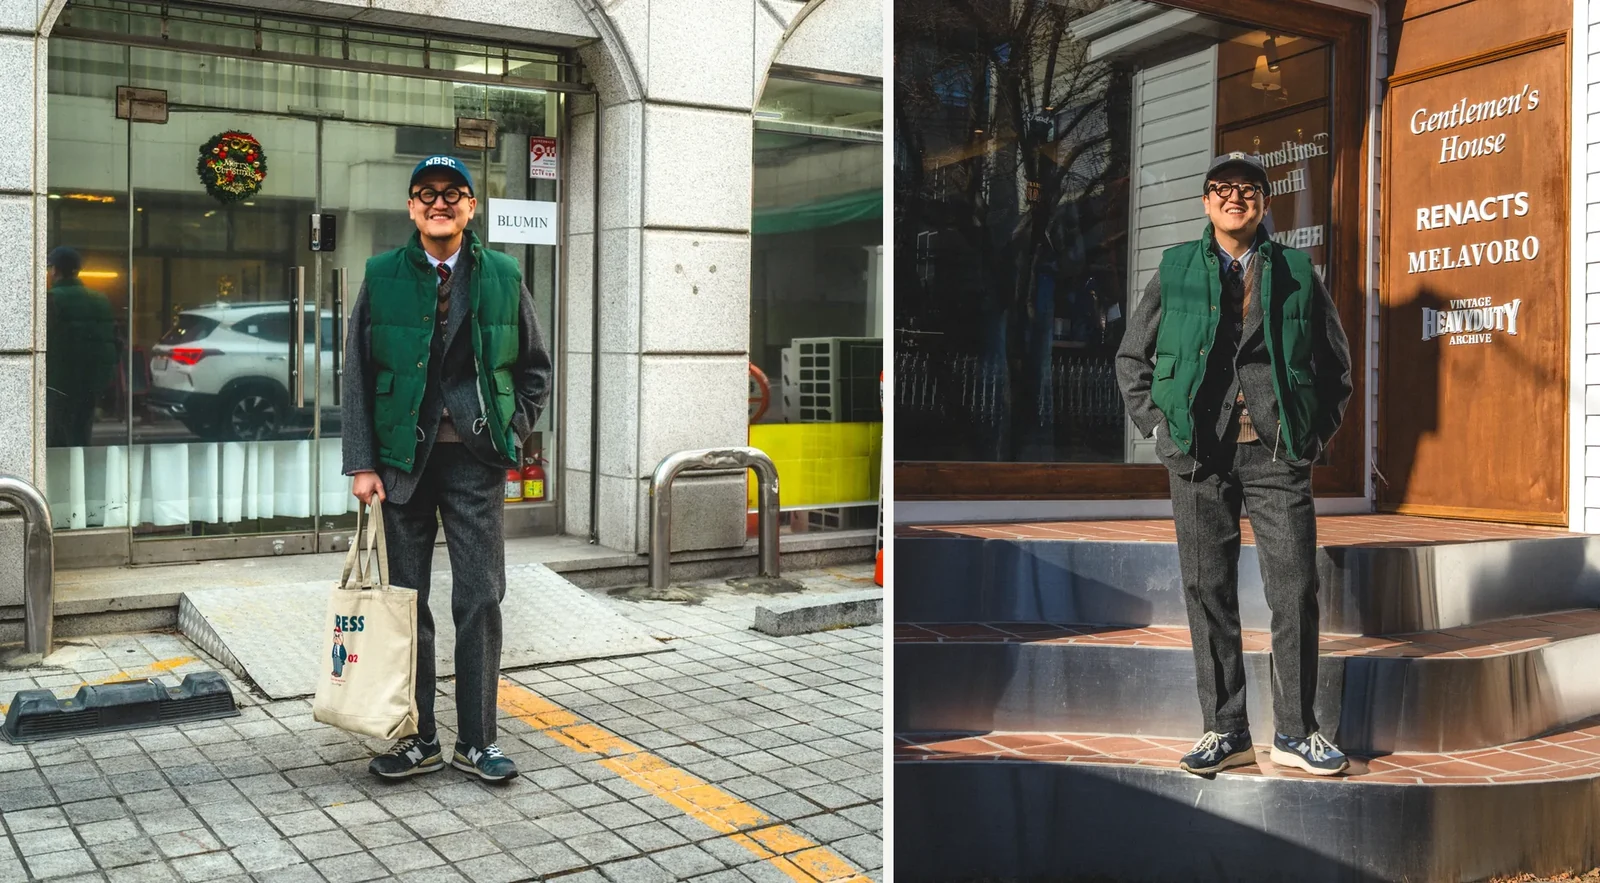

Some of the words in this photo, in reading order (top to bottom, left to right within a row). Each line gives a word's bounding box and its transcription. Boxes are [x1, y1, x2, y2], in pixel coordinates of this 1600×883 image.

[1410, 84, 1540, 135] Gentlemen's
[532, 144, 556, 162] 911
[1438, 133, 1507, 164] House
[223, 158, 249, 168] Merry
[425, 156, 456, 168] NBSC
[532, 168, 545, 176] CCTV
[1416, 191, 1530, 231] RENACTS
[497, 215, 548, 228] BLUMIN
[1407, 235, 1540, 274] MELAVORO
[1450, 296, 1492, 309] VINTAGE
[1421, 298, 1522, 341] HEAVYDUTY
[1449, 333, 1492, 345] ARCHIVE
[347, 654, 358, 663] 02
[405, 746, 423, 764] N
[467, 746, 483, 764] N
